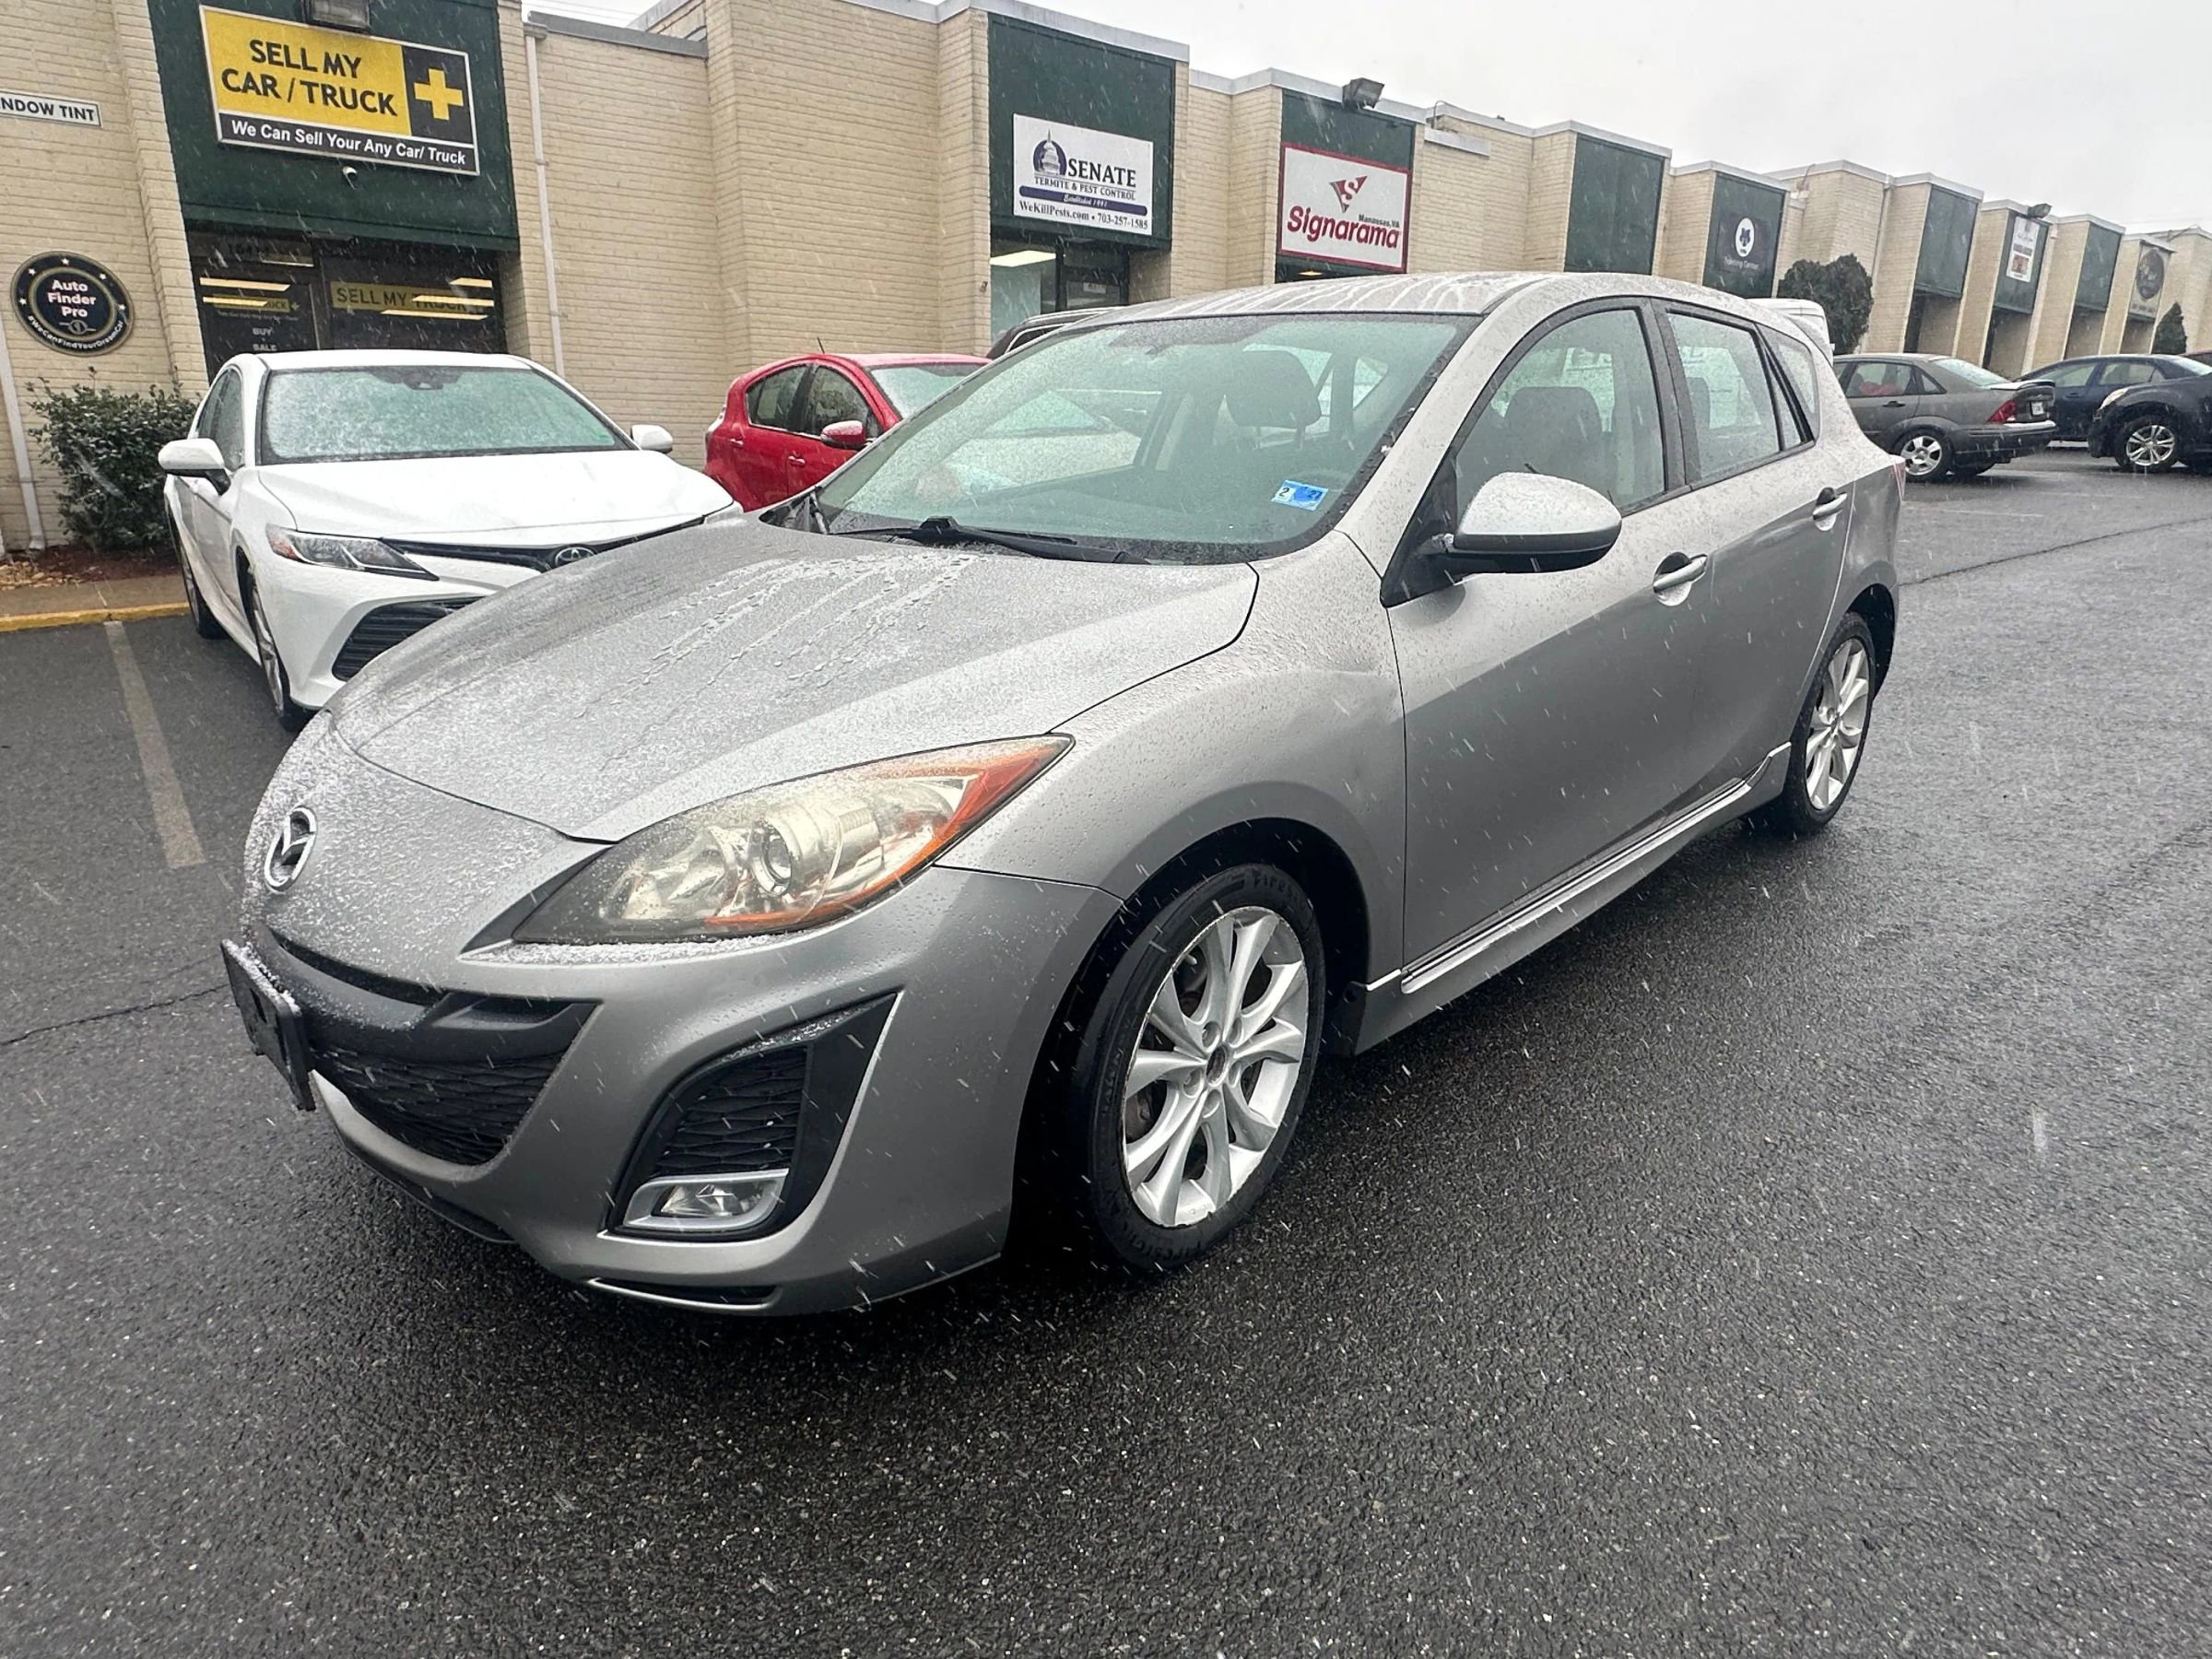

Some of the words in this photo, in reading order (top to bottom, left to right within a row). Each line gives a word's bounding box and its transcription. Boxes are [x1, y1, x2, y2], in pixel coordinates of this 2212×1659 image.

[249, 39, 318, 73] SELL
[323, 51, 362, 79] MY
[221, 68, 282, 100] CAR
[300, 79, 398, 117] TRUCK
[0, 97, 54, 116] NDOW
[58, 104, 95, 122] TINT
[231, 119, 257, 137] We
[260, 124, 291, 142] Can
[294, 128, 324, 147] Sell
[326, 132, 361, 151] Your
[363, 138, 393, 159] Any
[395, 142, 425, 159] Car/
[427, 147, 466, 166] Truck
[1067, 158, 1136, 188] SENATE
[1034, 176, 1069, 191] TERMITE
[1071, 182, 1078, 192] &
[1079, 183, 1098, 195] PEST
[1100, 188, 1136, 201] CONTROL
[1018, 200, 1089, 221] WeKillPests.com
[1097, 212, 1148, 230] 703-257-1585
[1287, 205, 1401, 250] Signarama
[47, 291, 97, 305] Finder
[52, 279, 88, 292] Auto
[336, 286, 381, 306] SELL
[383, 290, 408, 307] MY
[61, 305, 88, 318] Pro
[252, 327, 274, 336] BUY
[1278, 487, 1290, 498] 2
